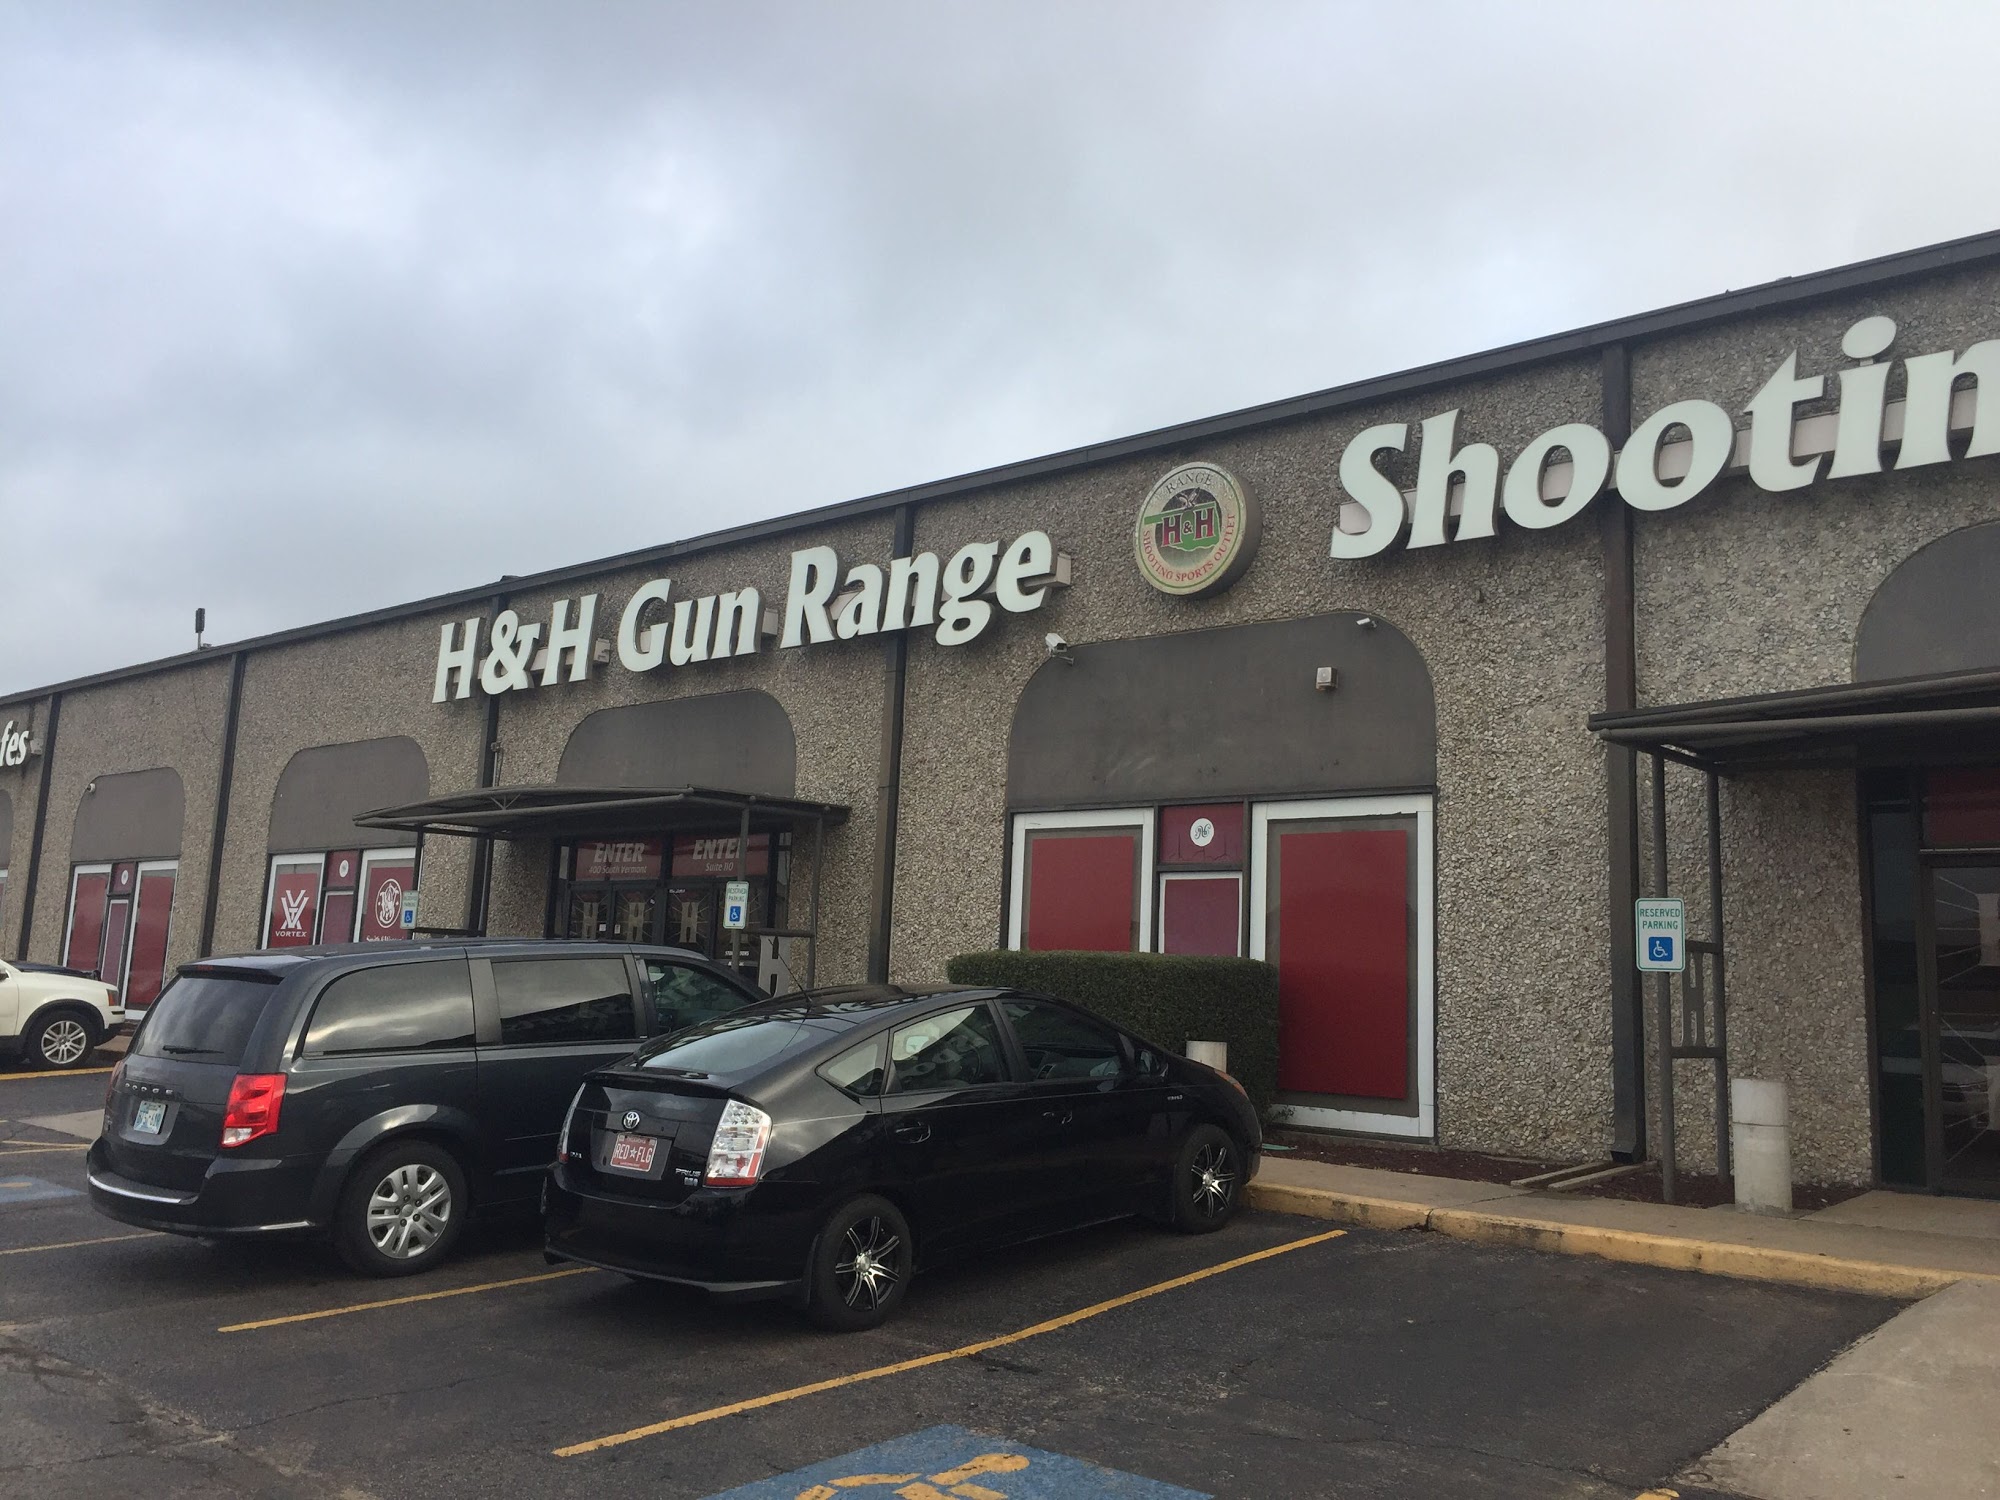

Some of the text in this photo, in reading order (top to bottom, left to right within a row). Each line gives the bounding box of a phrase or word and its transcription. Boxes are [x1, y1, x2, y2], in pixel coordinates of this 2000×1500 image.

[1166, 472, 1212, 493] RANGE
[1160, 506, 1216, 548] H&H
[1143, 513, 1236, 582] SHOOTING SPORTS OUTLET
[432, 530, 1056, 704] H&H Gun Range
[594, 842, 645, 862] ENTER
[602, 865, 620, 874] South
[621, 865, 648, 874] Vermont
[705, 862, 722, 872] Suite
[1639, 908, 1680, 918] RESERVED
[275, 930, 307, 938] VORTEX
[1642, 920, 1678, 930] PARKING
[614, 1143, 653, 1163] RED FLG
